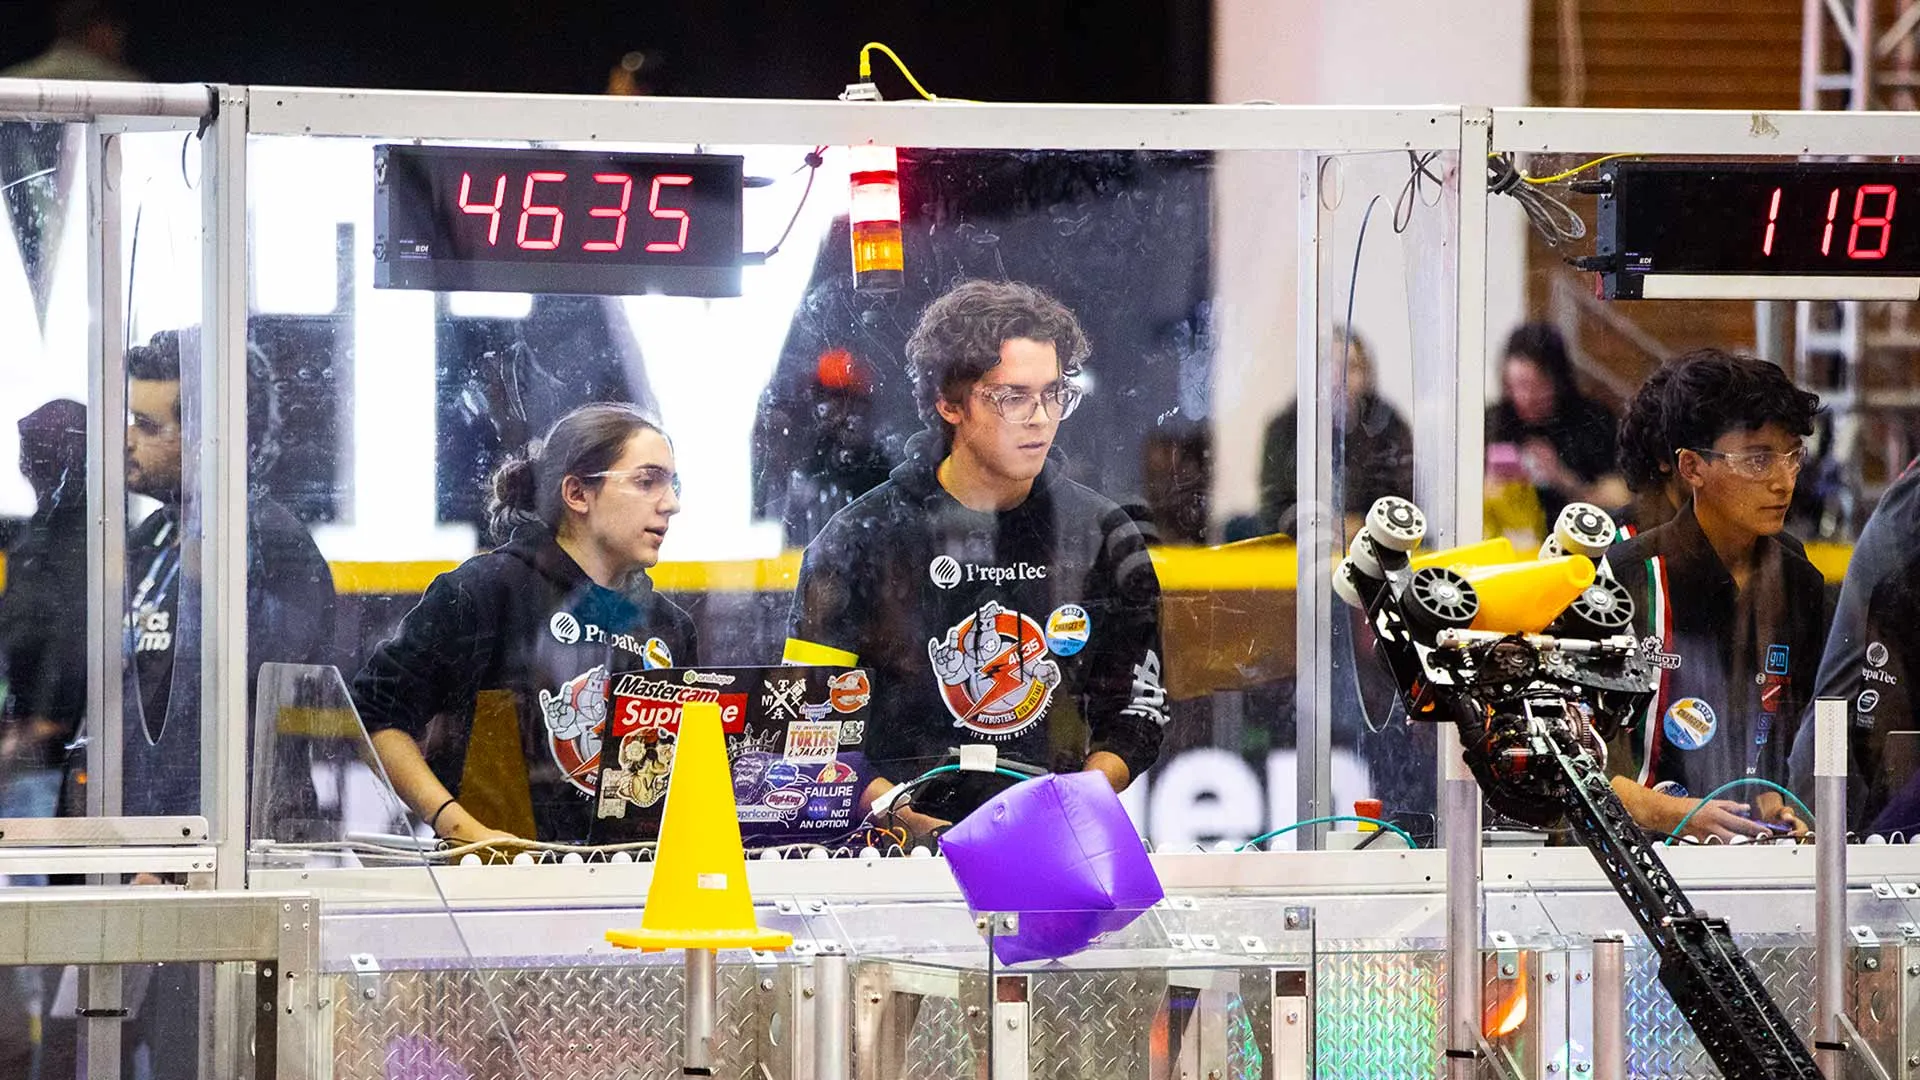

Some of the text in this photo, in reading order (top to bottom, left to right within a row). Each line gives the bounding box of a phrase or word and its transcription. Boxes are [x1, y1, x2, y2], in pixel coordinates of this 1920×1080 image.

[458, 172, 694, 252] 4635
[1763, 184, 1898, 260] 118
[965, 562, 1047, 586] PrepaTec
[1862, 667, 1897, 685] epaTec
[616, 675, 718, 703] Mastercam
[621, 699, 739, 728] Supre
[789, 730, 838, 748] TORTAS
[804, 785, 854, 798] FAILURE
[842, 798, 852, 808] IS
[735, 807, 780, 820] apricorn
[830, 808, 850, 818] NOT
[799, 818, 850, 829] AN OPTION
